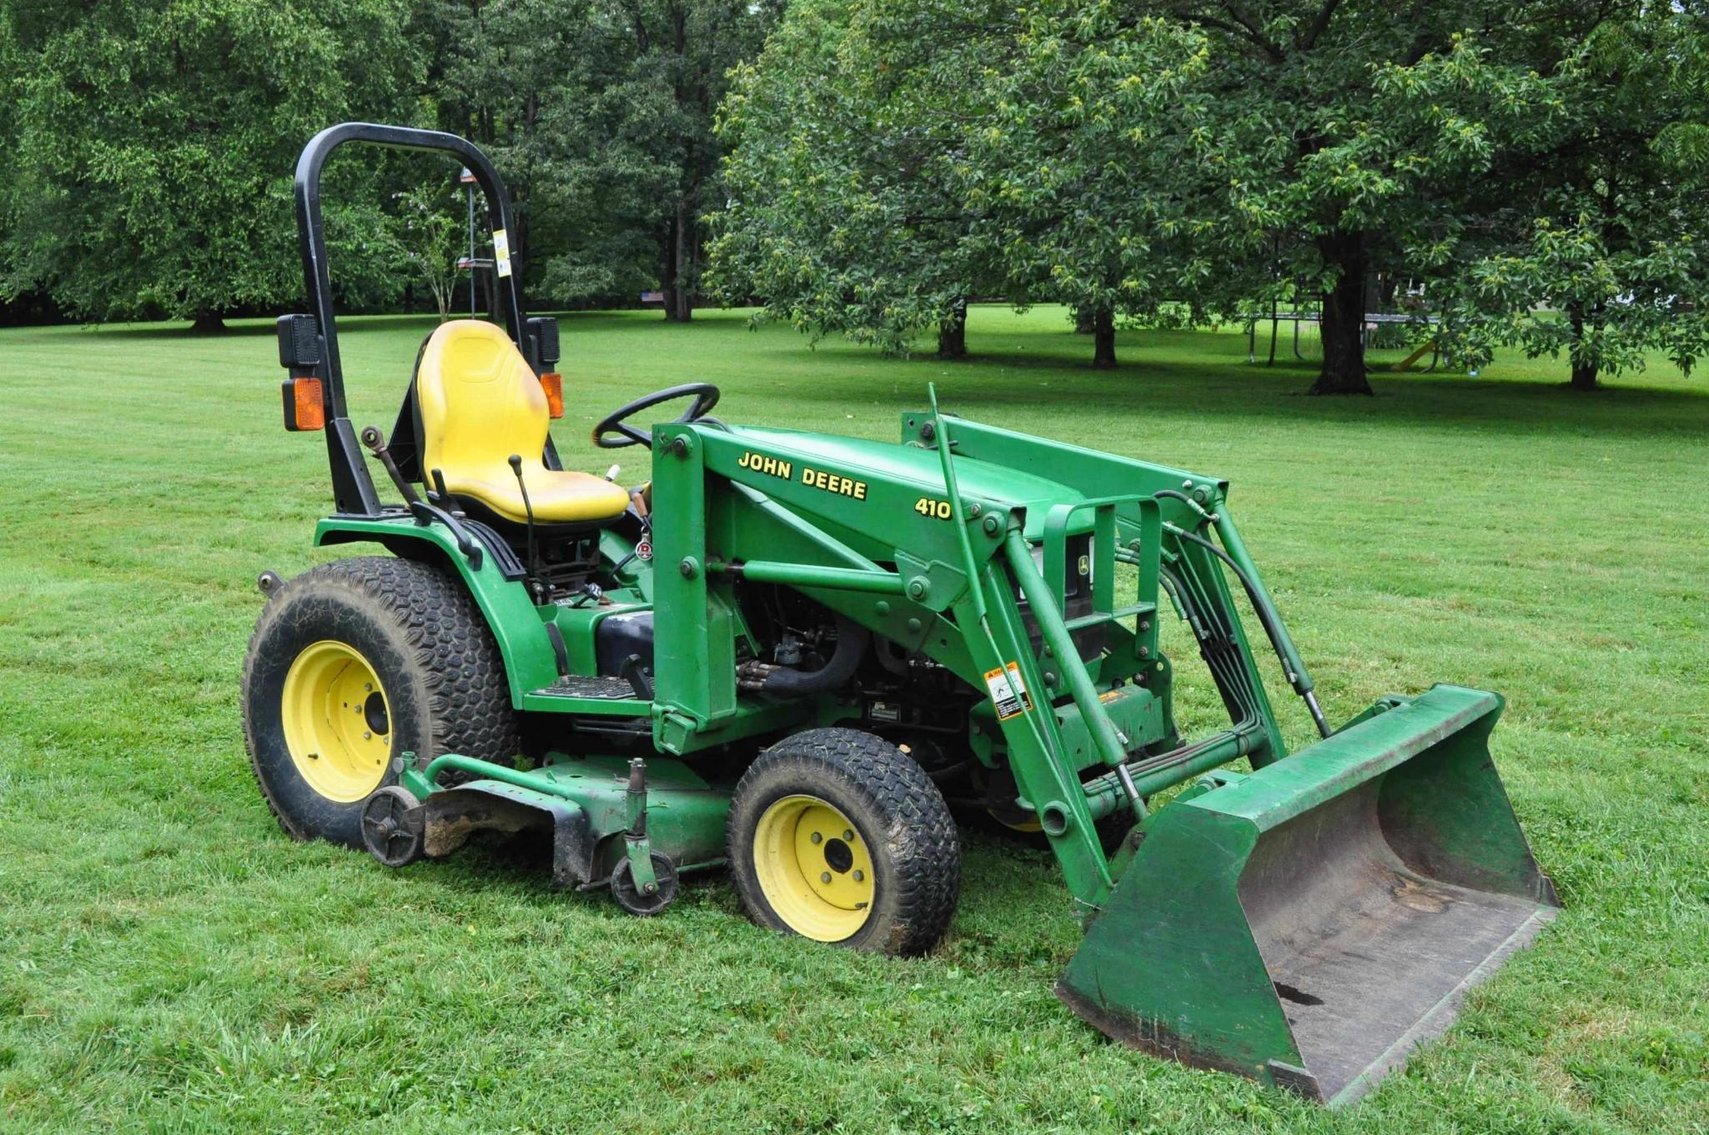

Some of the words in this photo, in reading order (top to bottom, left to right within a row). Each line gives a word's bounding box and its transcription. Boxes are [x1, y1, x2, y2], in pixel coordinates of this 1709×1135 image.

[738, 452, 791, 479] JOHN
[802, 468, 867, 500] DEERE
[914, 497, 952, 520] 410
